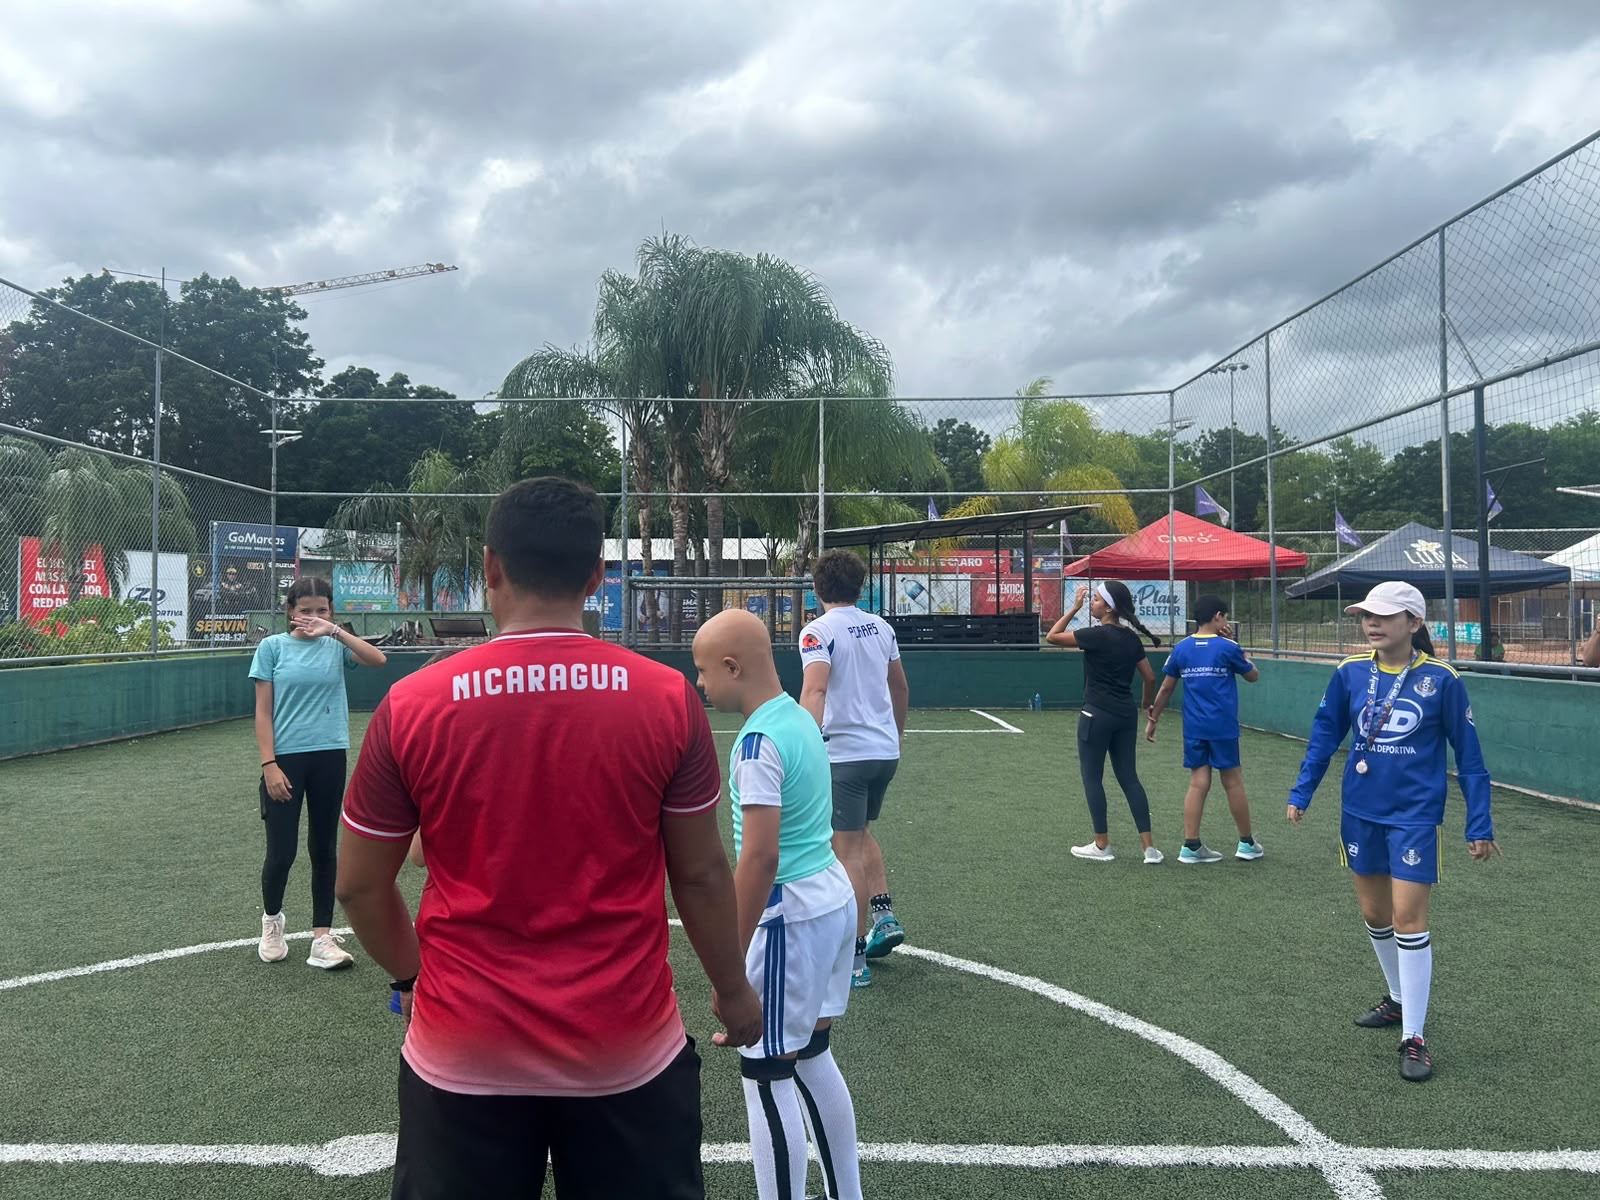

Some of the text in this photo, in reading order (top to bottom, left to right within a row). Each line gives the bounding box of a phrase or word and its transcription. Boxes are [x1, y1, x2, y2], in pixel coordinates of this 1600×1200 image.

[1157, 532, 1210, 544] Claro
[28, 583, 51, 595] CON
[52, 584, 66, 595] LA
[32, 597, 54, 608] RED
[1139, 606, 1181, 616] SELTZER
[452, 663, 629, 702] NICARAGUA
[1377, 744, 1417, 755] DEPORTIVA
